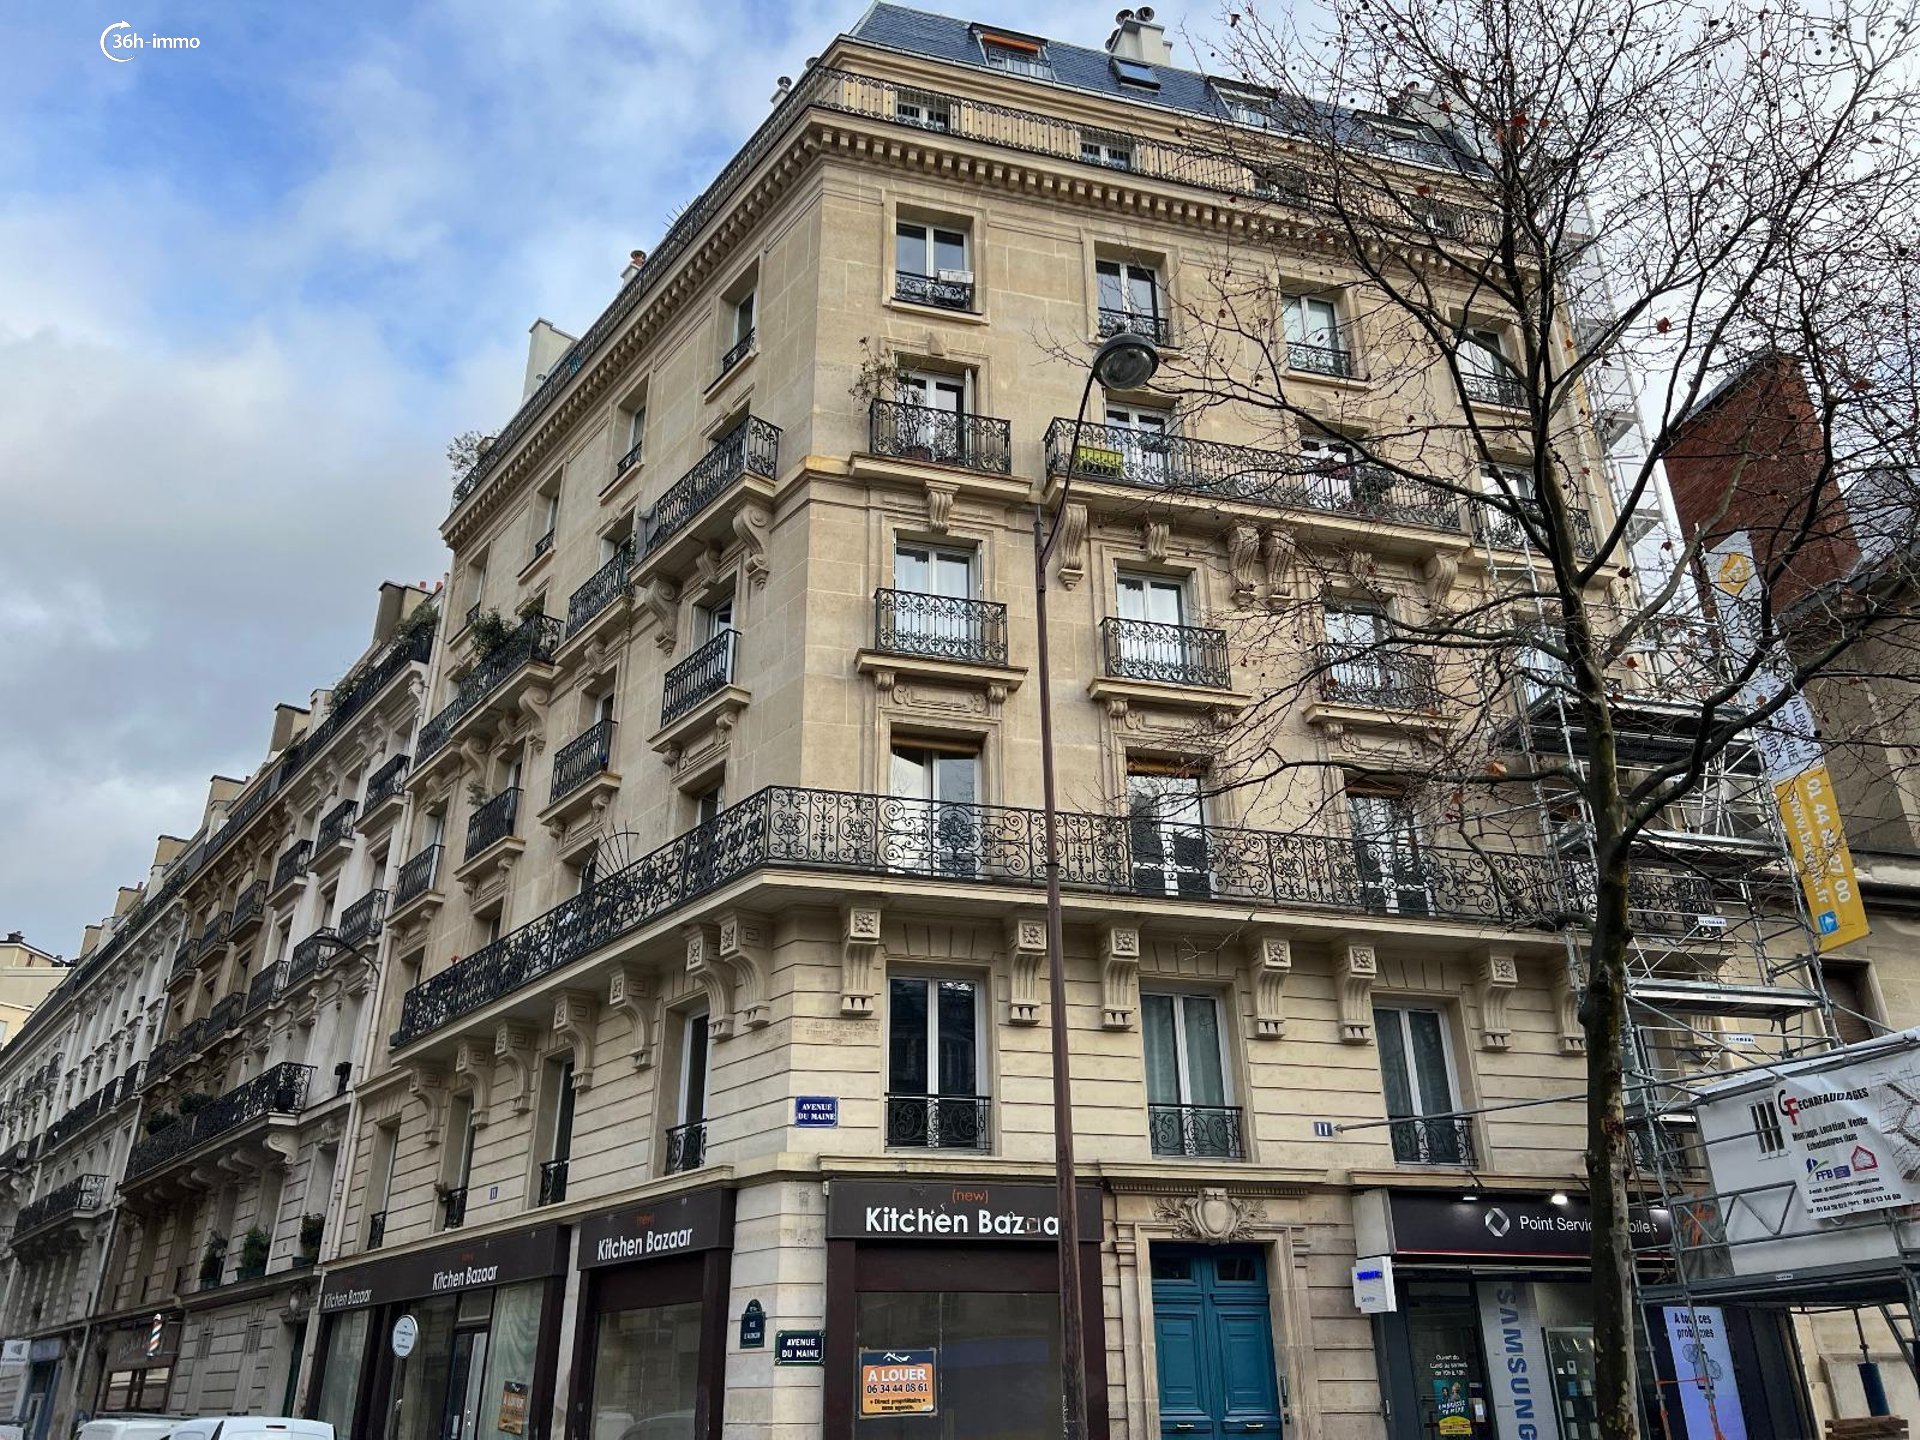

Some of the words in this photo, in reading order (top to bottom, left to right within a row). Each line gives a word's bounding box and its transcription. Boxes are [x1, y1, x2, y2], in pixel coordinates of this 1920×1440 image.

[1807, 778, 1823, 799] 01
[1813, 803, 1830, 825] 44
[1835, 880, 1851, 903] 00
[802, 1103, 833, 1111] AVENUE
[1816, 1169, 1834, 1181] FFB
[952, 1189, 989, 1204] (new)
[865, 1206, 969, 1234] Kitchen
[1519, 1215, 1554, 1231] Point
[597, 1235, 643, 1261] Kitchen
[646, 1228, 693, 1253] Bazaar
[432, 1269, 465, 1291] Kitchen
[466, 1265, 499, 1285] Bazaar
[1699, 1315, 1712, 1324] ces
[787, 1338, 816, 1346] AVENUE
[782, 1349, 793, 1358] DU
[796, 1349, 819, 1358] MAINE
[1497, 1288, 1538, 1440] SAMSUNG
[867, 1369, 878, 1382] A
[881, 1368, 927, 1382] LOUER
[867, 1384, 878, 1394] 06
[880, 1384, 890, 1393] 34
[892, 1384, 903, 1393] 44
[918, 1383, 928, 1392] 61
